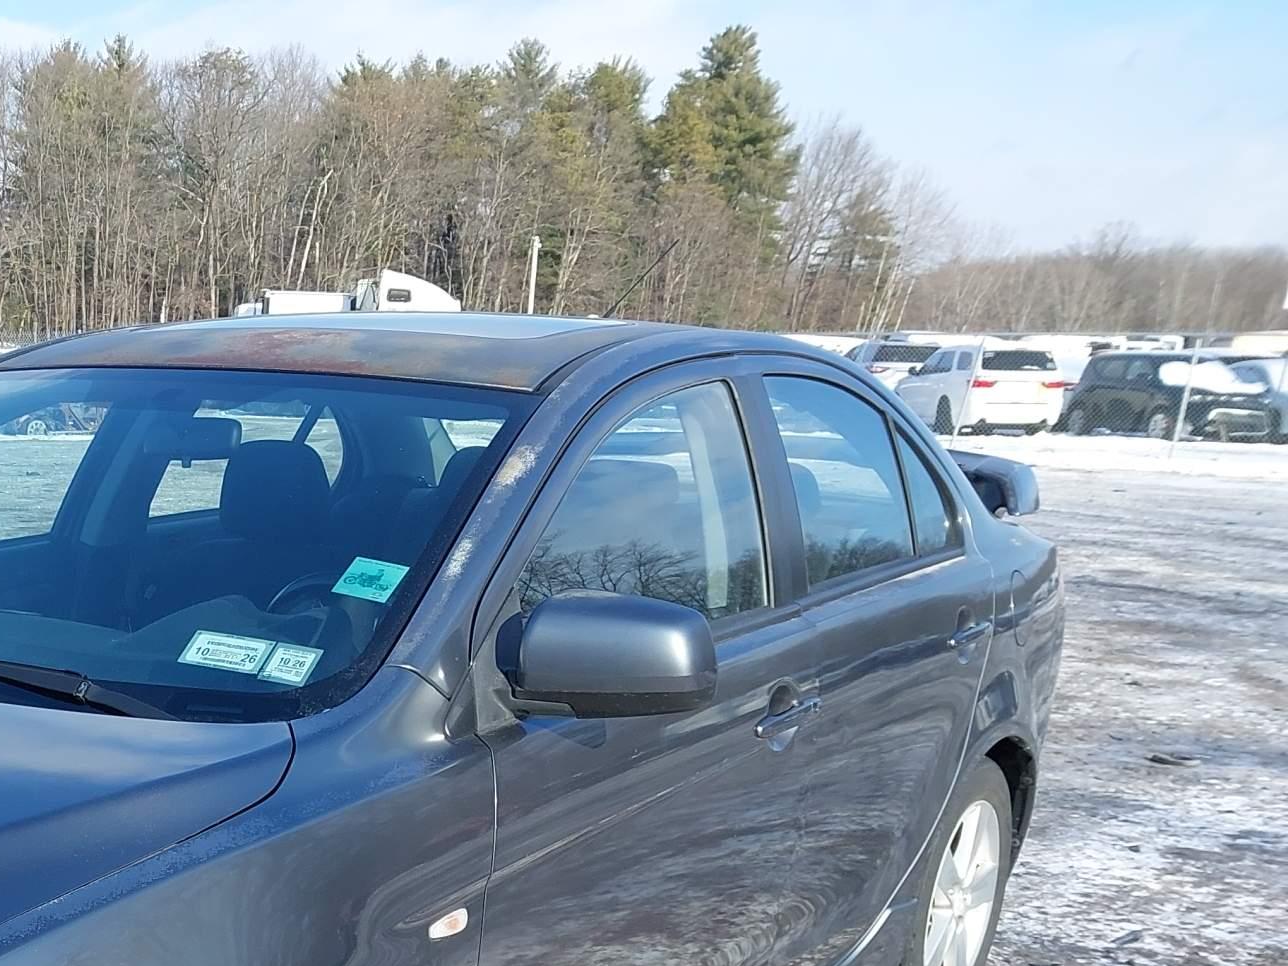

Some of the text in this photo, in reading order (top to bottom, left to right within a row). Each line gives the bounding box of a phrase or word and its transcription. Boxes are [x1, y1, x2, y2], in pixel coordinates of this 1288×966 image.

[195, 646, 211, 657] 10
[240, 653, 259, 664] 26
[279, 656, 306, 668] 10 26
